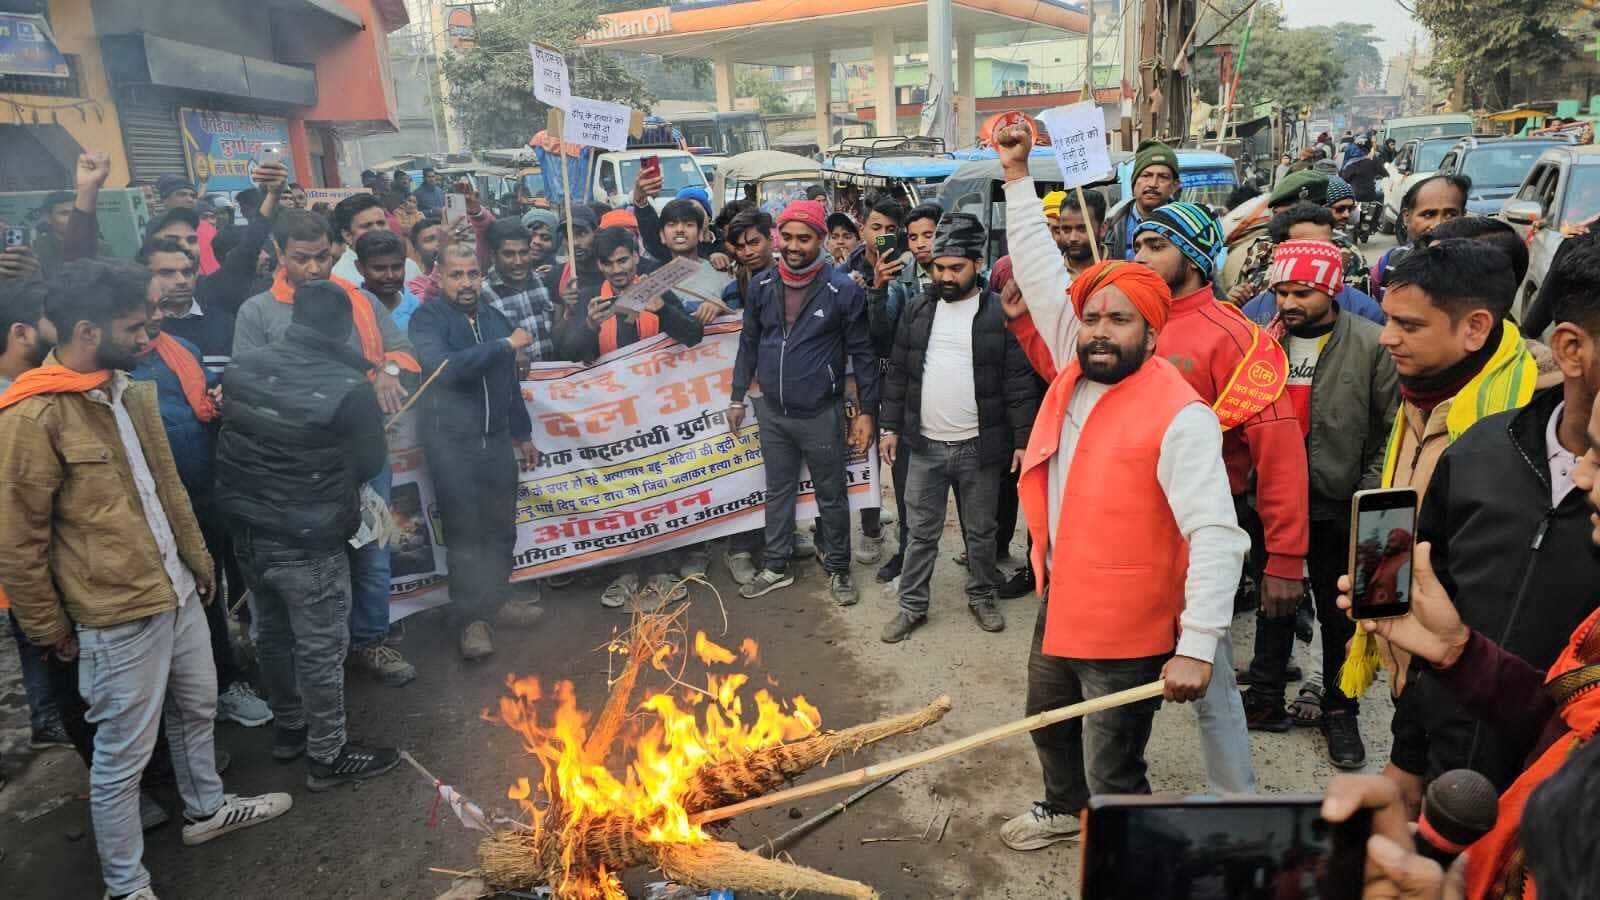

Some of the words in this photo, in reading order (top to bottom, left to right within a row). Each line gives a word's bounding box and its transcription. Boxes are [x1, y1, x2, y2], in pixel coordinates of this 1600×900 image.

[1252, 365, 1275, 382] राम
[538, 394, 641, 438] दल
[664, 512, 690, 530] पर
